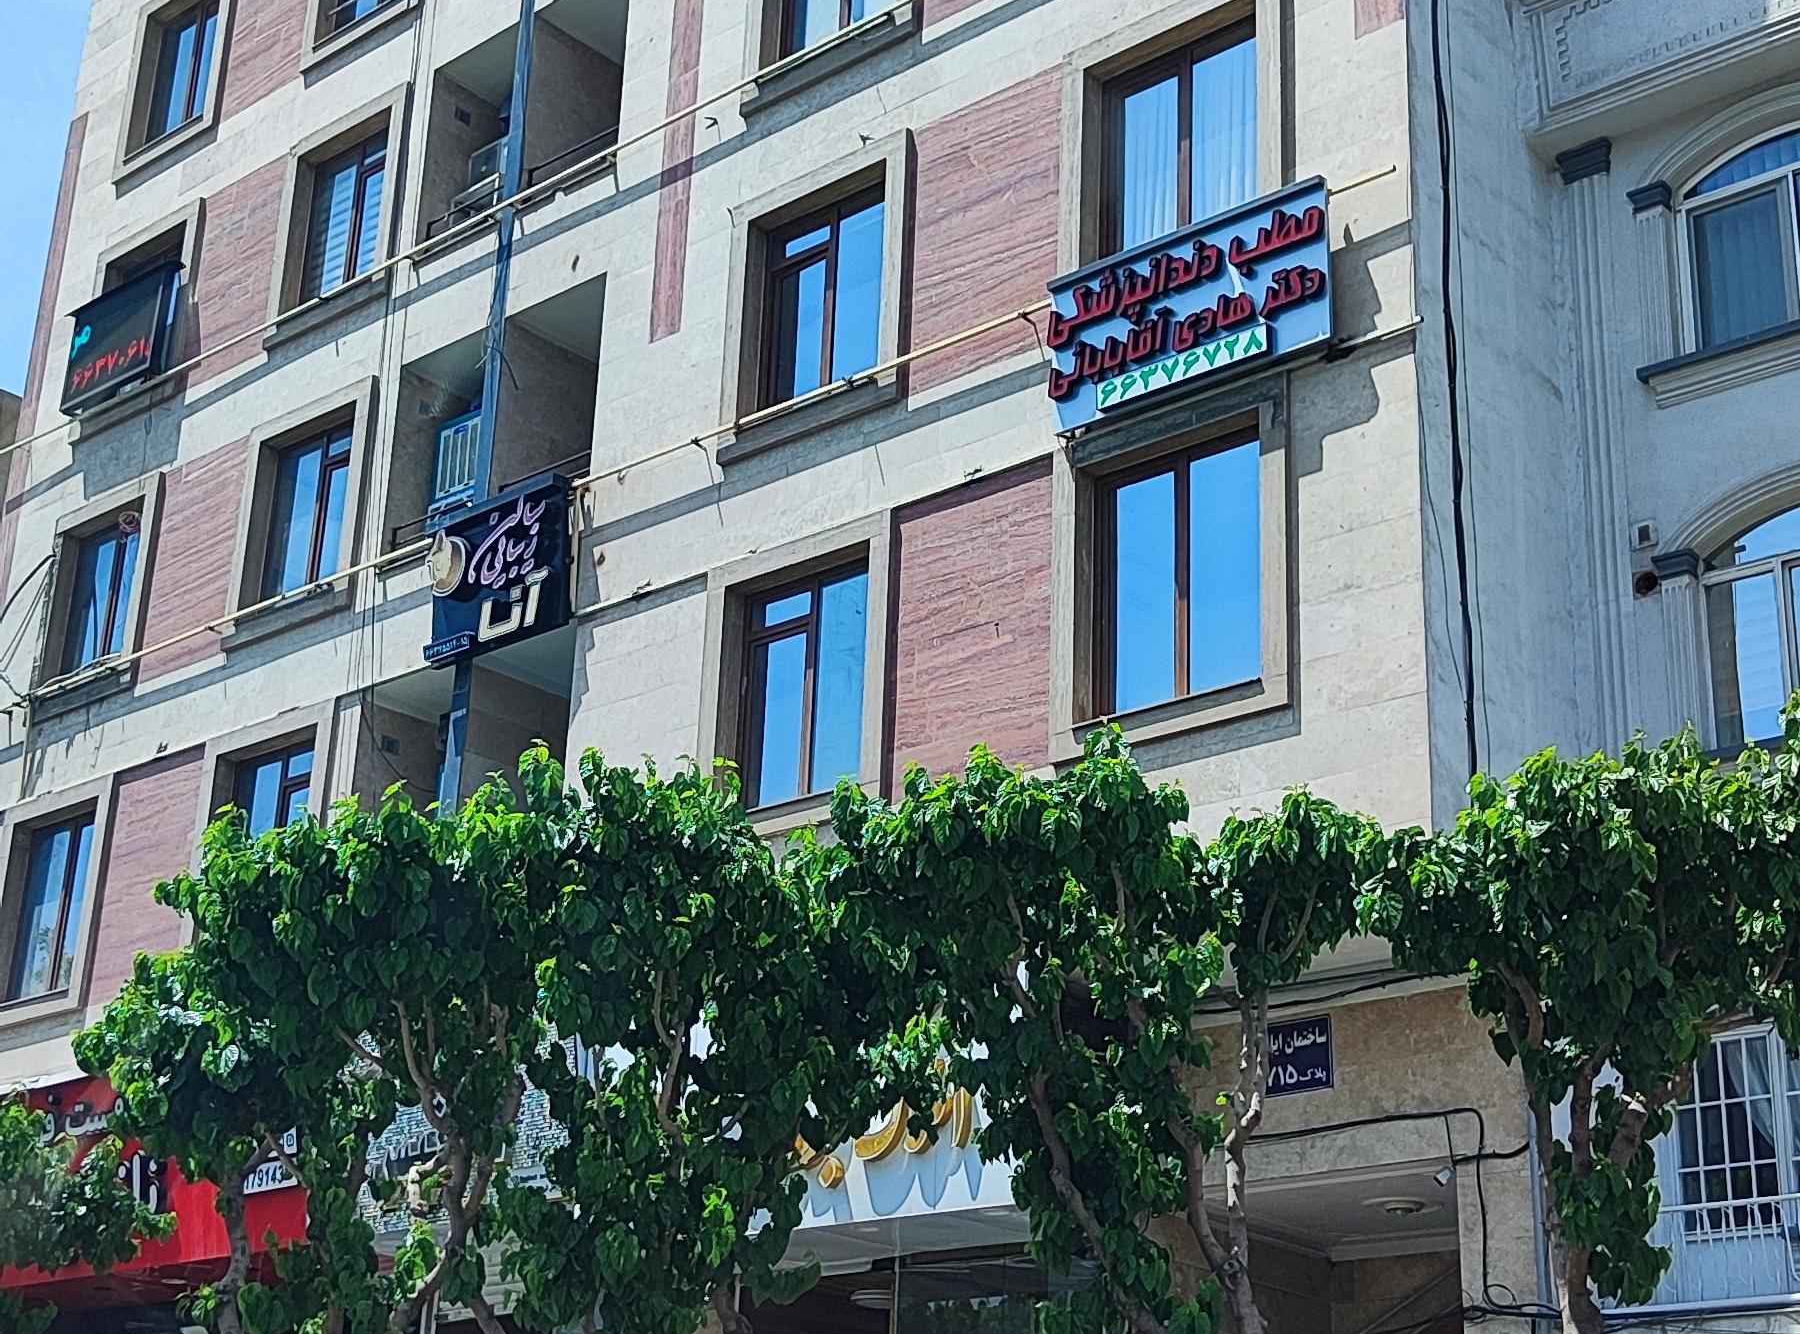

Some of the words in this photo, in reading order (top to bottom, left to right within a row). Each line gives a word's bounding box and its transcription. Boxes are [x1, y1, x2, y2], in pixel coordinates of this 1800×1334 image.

[1228, 206, 1324, 275] مطب
[1048, 240, 1222, 347] دندانپزشکی
[1174, 292, 1253, 352] هادی
[1259, 265, 1325, 317] دکتر
[1101, 330, 1264, 406] ۶۶۳۷۶۷۲۸
[468, 495, 546, 583] سالن
[481, 523, 538, 589] زیبایی
[478, 566, 549, 642] آنا
[1284, 1027, 1327, 1054] ساختمان
[1299, 1067, 1326, 1082] پلاک
